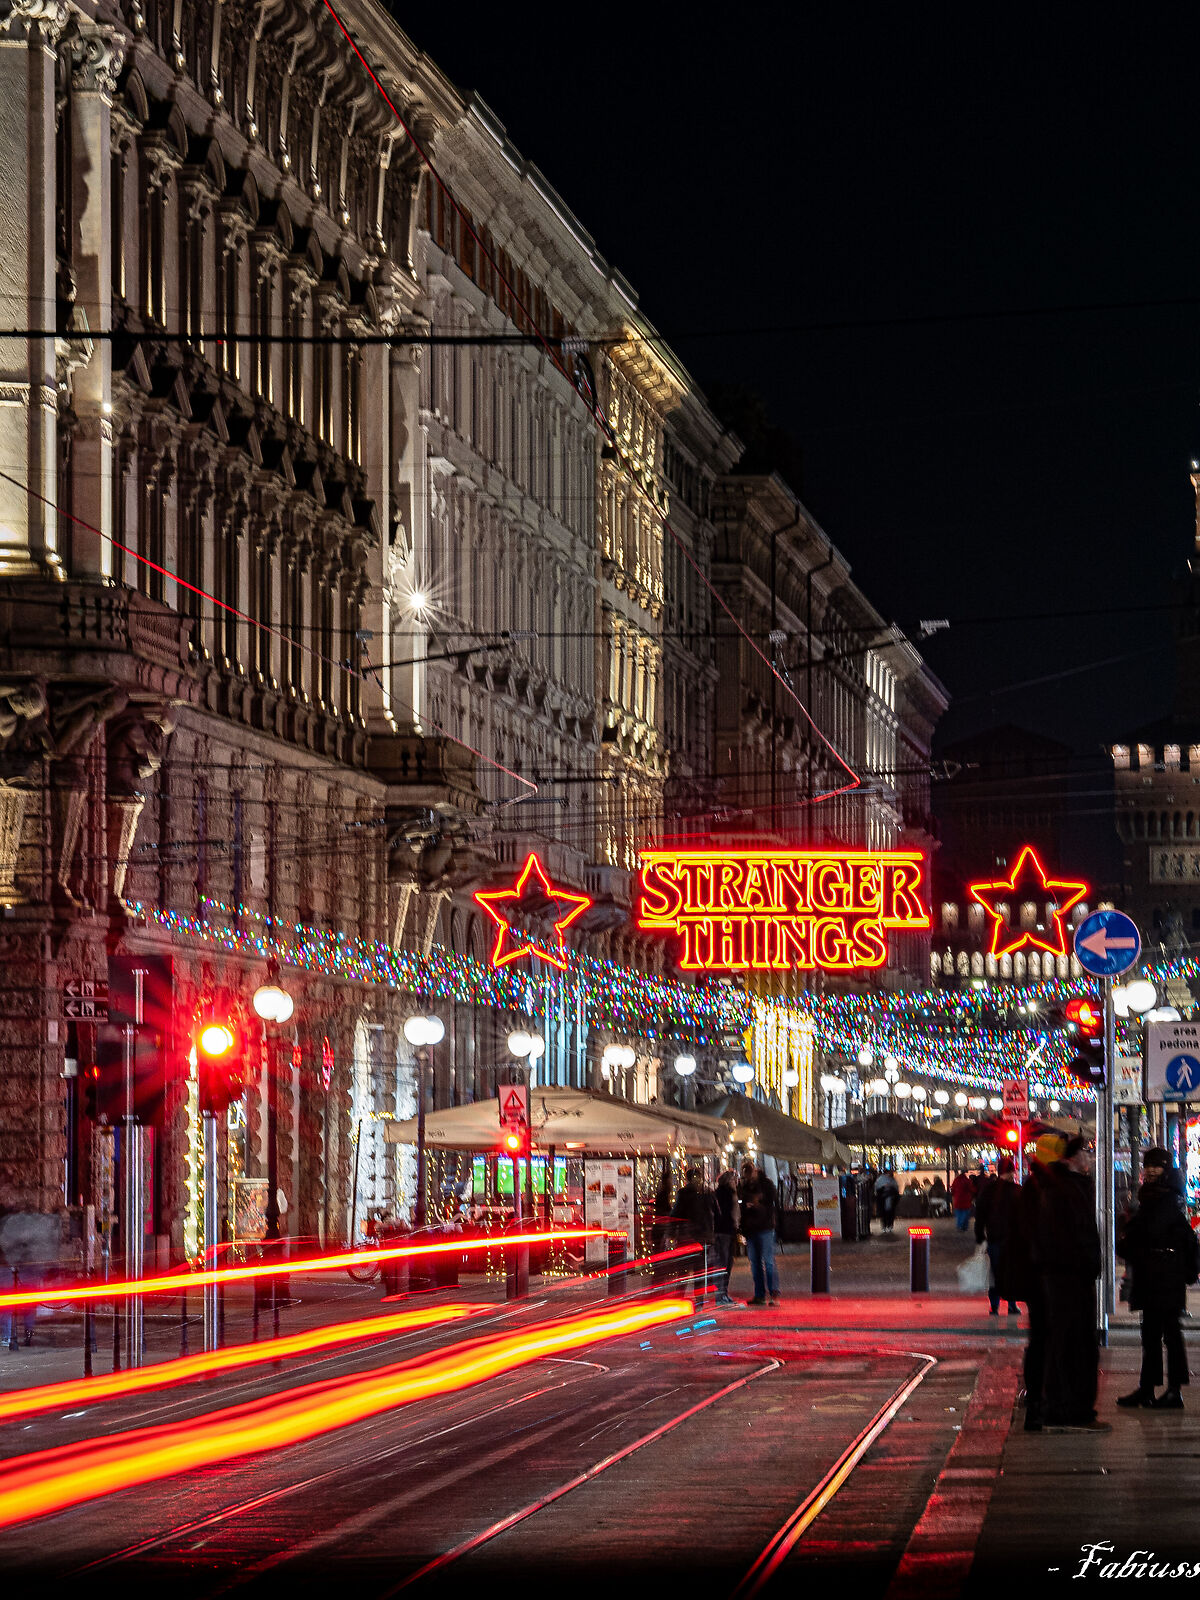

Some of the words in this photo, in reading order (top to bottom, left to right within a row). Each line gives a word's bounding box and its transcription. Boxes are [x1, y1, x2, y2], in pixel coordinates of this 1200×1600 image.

[640, 858, 929, 927] STRANGER
[676, 915, 887, 969] THINGS
[1173, 1026, 1198, 1036] area
